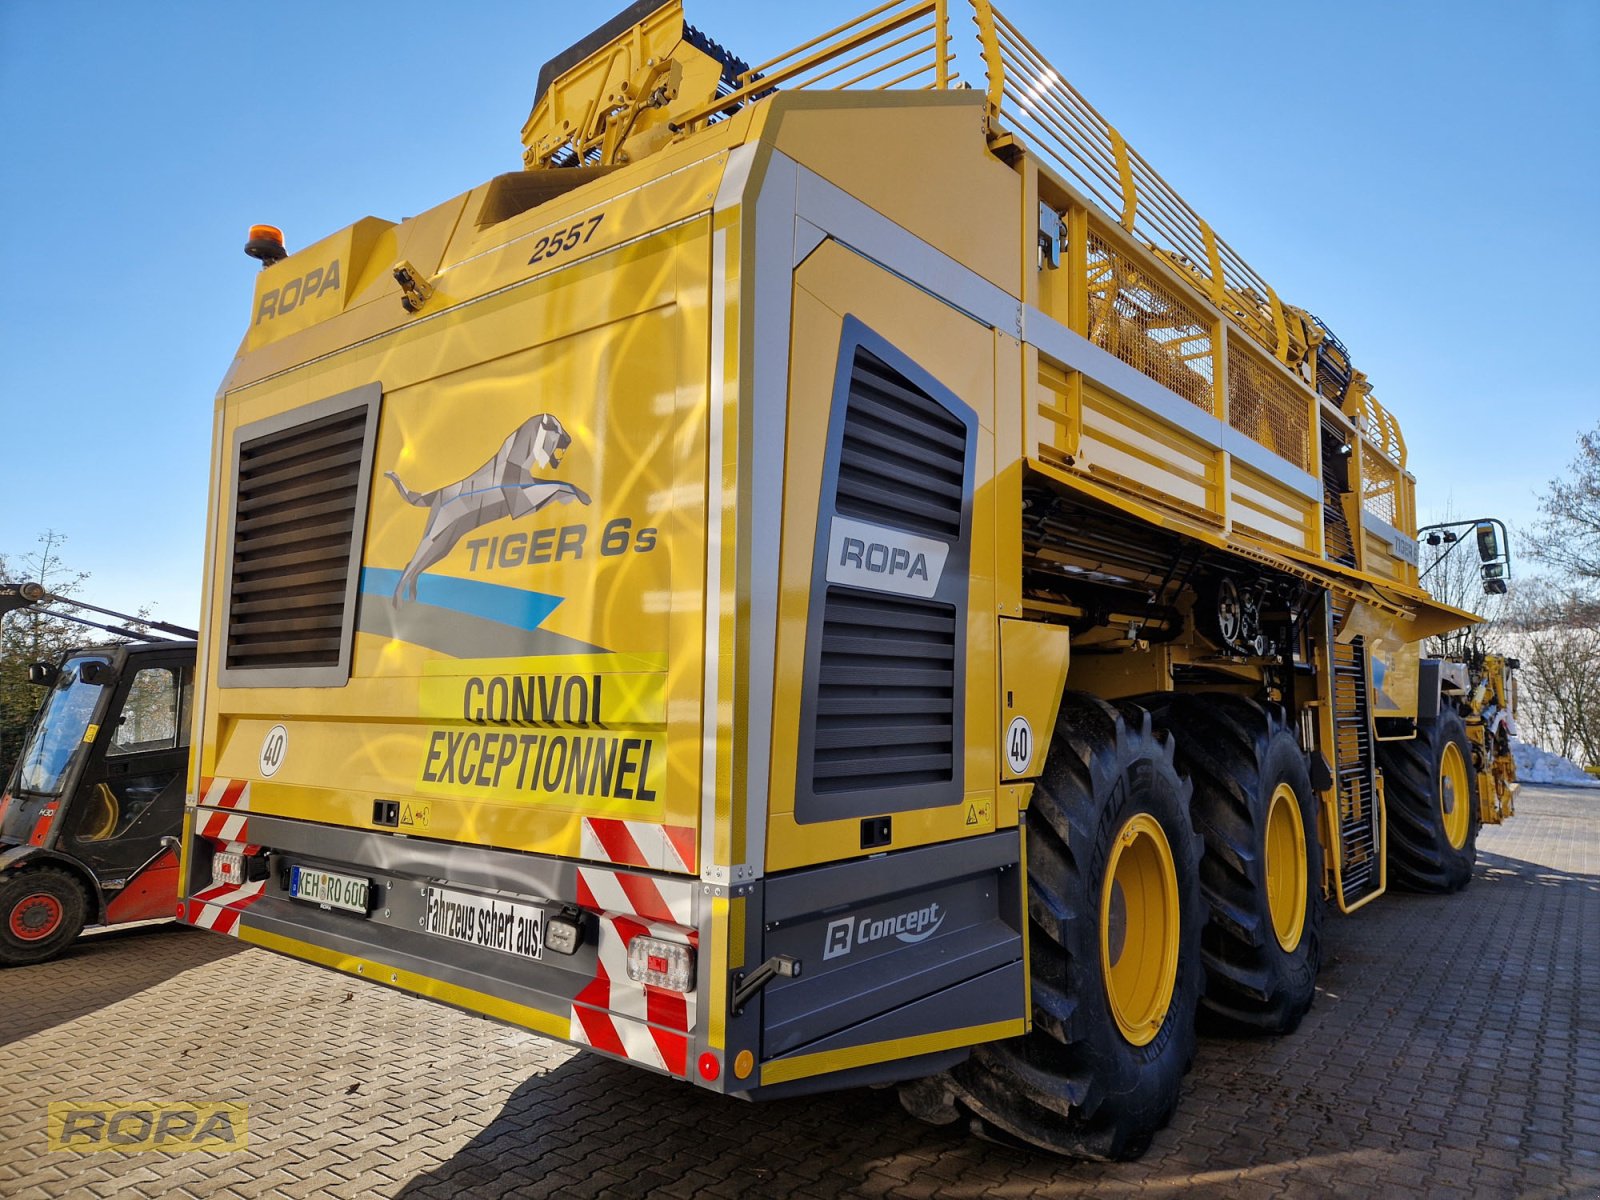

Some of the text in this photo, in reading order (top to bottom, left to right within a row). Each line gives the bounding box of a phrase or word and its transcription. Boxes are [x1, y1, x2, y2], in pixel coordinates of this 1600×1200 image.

[527, 213, 605, 266] 2557
[255, 258, 341, 326] ROPA
[466, 523, 588, 572] TIGER
[840, 536, 929, 582] ROPA
[463, 674, 603, 725] CONVOI
[263, 733, 284, 767] 40
[421, 730, 657, 802] EXCEPTIONNEL
[1011, 727, 1028, 762] 40
[299, 871, 368, 908] KEH RO 600
[427, 887, 544, 959] Fahrzeug schert aus!
[857, 902, 940, 945] Concept
